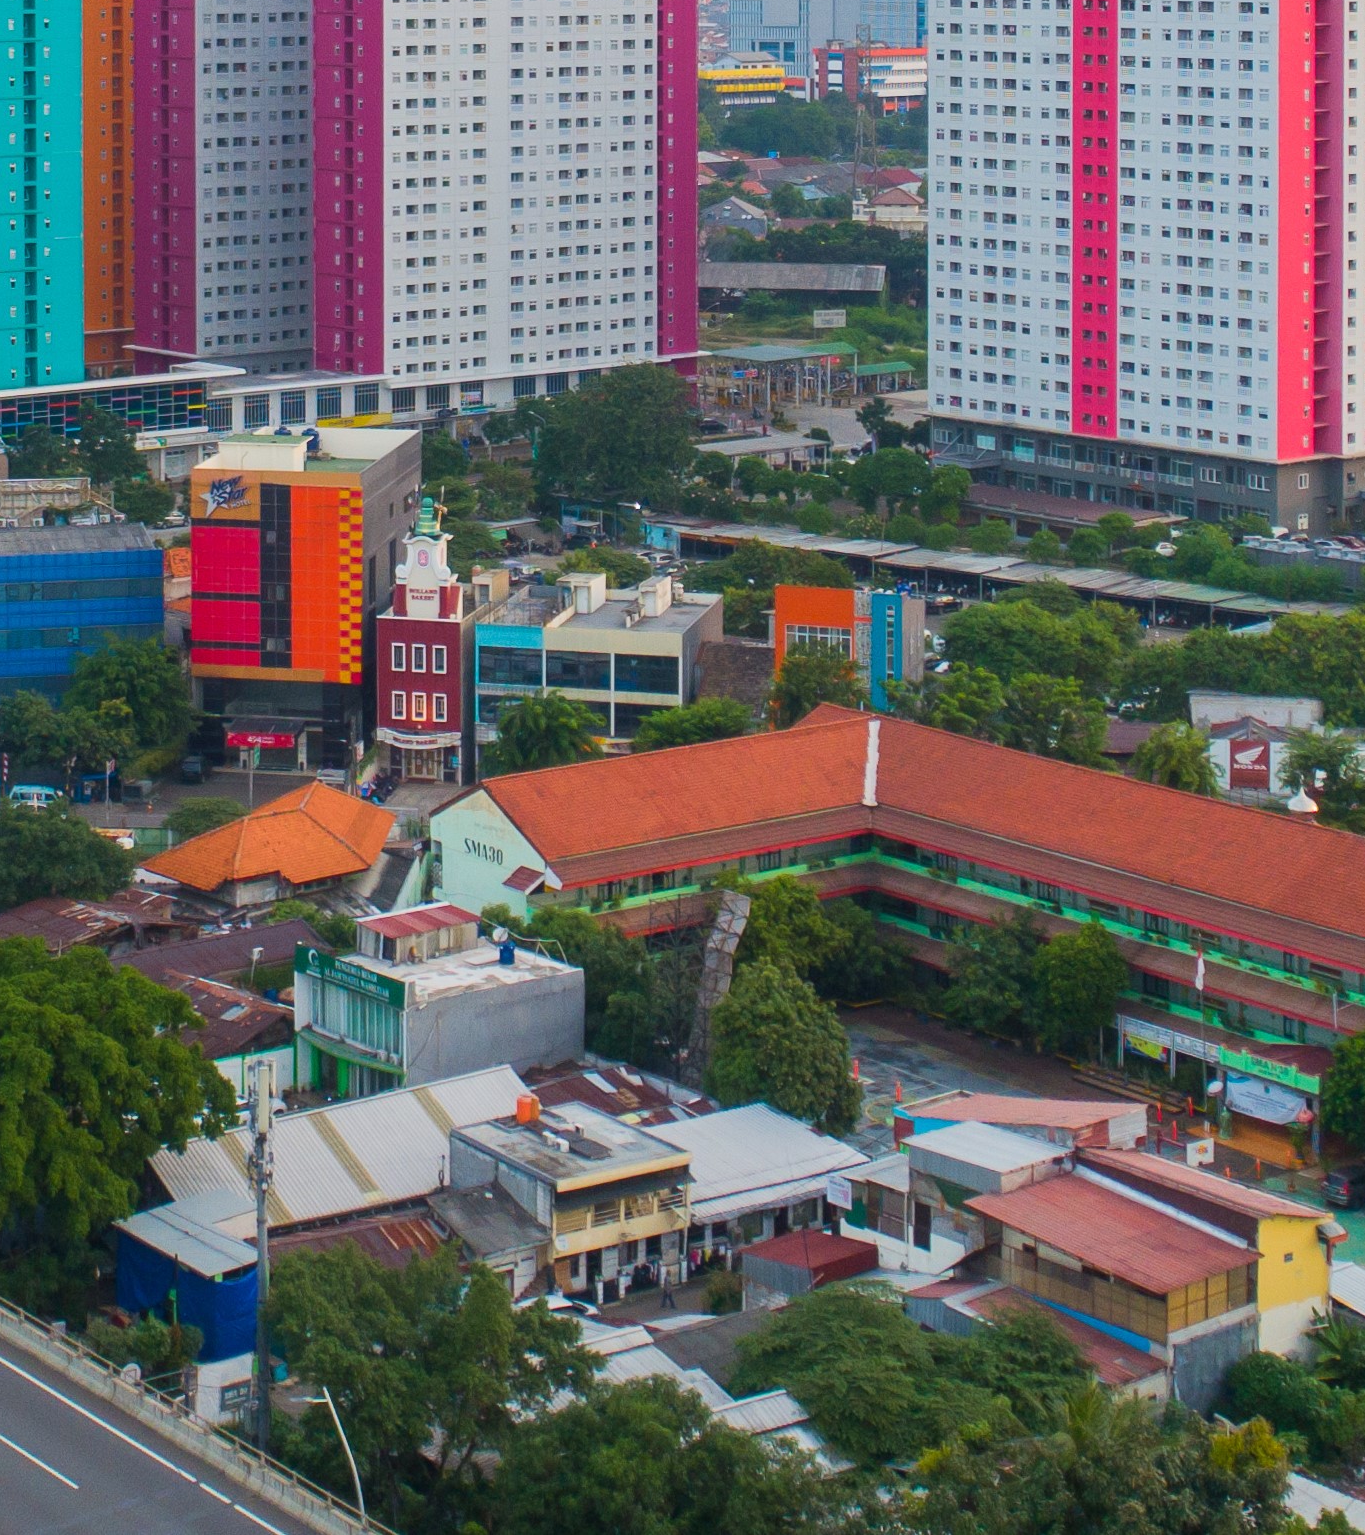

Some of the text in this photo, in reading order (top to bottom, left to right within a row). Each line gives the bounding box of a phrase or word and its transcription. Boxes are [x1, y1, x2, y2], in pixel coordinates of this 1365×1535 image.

[211, 476, 242, 497] New
[213, 487, 247, 506] Star
[232, 499, 252, 509] HOTEL
[1233, 763, 1268, 771] HONDA
